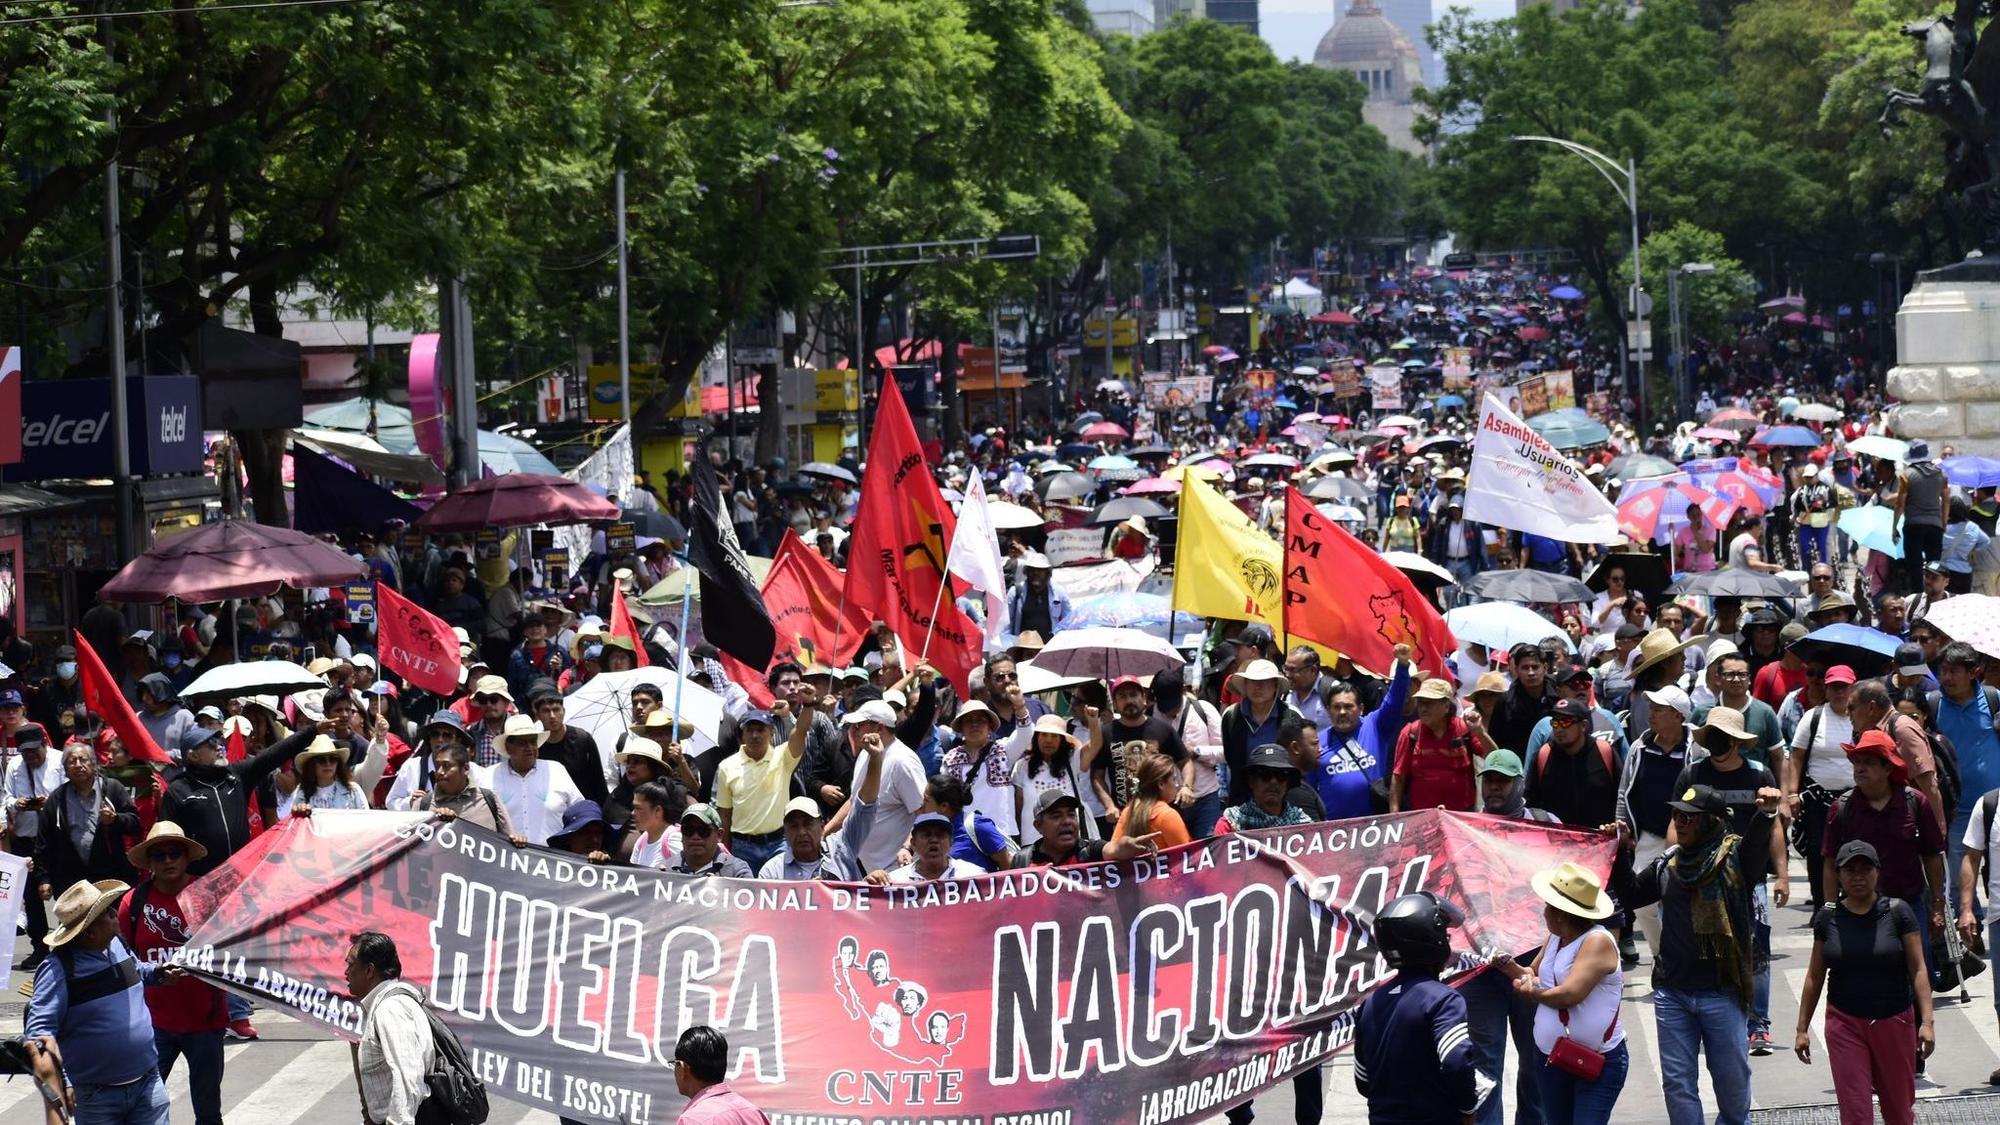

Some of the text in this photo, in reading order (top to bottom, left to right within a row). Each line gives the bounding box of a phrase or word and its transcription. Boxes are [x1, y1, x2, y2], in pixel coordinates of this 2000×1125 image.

[161, 405, 187, 443] telcel
[391, 646, 439, 676] CNTE
[1326, 755, 1376, 775] adidas
[394, 822, 640, 897] COORDINADORA
[654, 879, 819, 911] NACIONAL
[832, 888, 870, 911] DE
[884, 865, 1121, 910] TRABAJADORES
[1134, 855, 1170, 884] DE
[1182, 847, 1215, 874] LA
[1227, 820, 1404, 864] EDUCACIÓN
[429, 872, 785, 1083] HUELGA
[222, 951, 248, 984] LA
[254, 967, 364, 1035] ABROGACI
[473, 1048, 509, 1086] LEY
[516, 1061, 553, 1102] DEL
[562, 1075, 652, 1125] ISSSTE!
[1272, 1042, 1300, 1078] DE
[826, 1069, 963, 1105] CNTE
